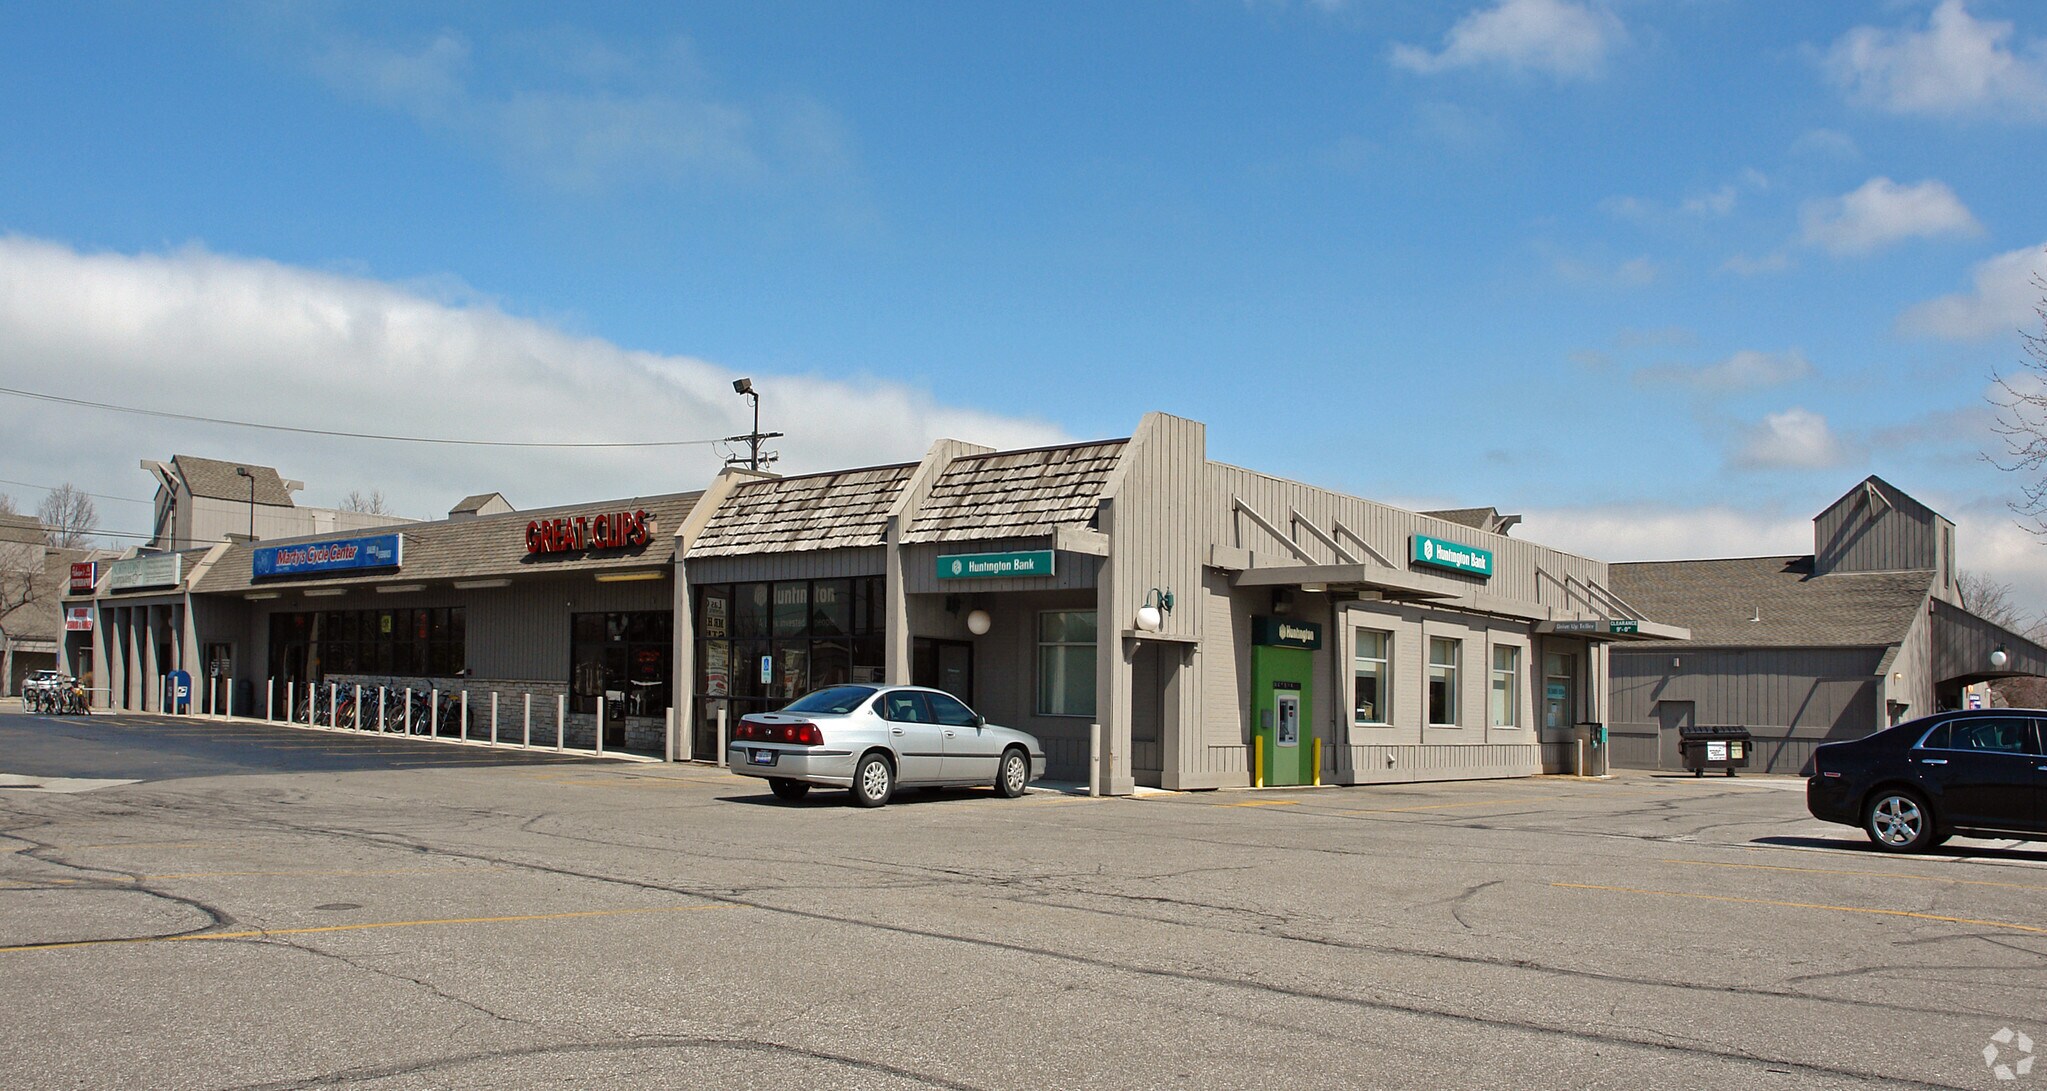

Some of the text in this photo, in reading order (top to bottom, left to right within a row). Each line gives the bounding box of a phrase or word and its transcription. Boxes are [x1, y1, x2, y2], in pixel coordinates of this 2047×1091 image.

[525, 509, 649, 554] GREAT CLIPS
[276, 543, 358, 567] Marty's Cycle Center
[968, 558, 1035, 574] Huntington Bank
[1436, 543, 1486, 570] Huntington Bank
[772, 584, 836, 605] untinton
[1286, 624, 1315, 643] Huntington
